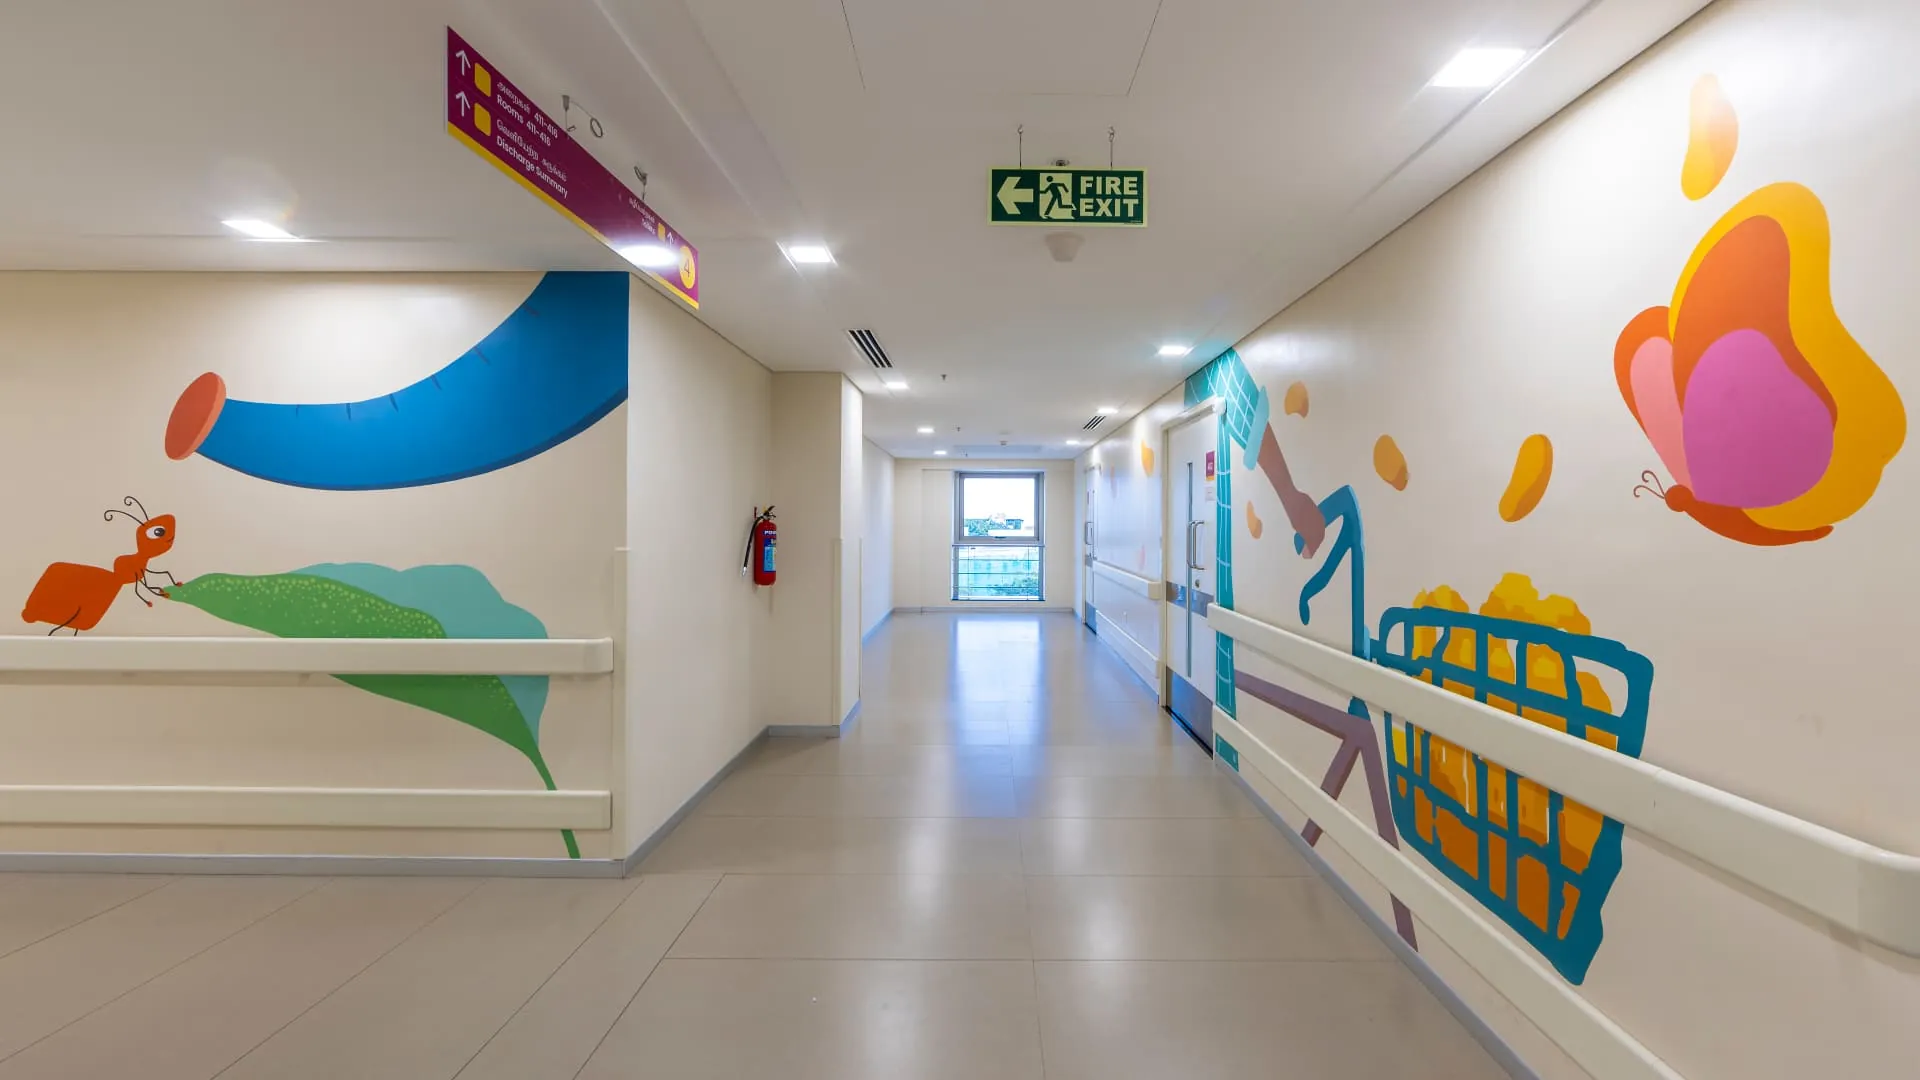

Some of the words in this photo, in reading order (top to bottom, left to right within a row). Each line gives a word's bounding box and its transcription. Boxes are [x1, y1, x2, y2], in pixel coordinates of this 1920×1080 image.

[497, 94, 524, 124] Rooms
[526, 120, 551, 147] 411-416
[534, 112, 558, 139] 411-416
[496, 135, 535, 172] Discharge
[535, 166, 568, 199] Summary
[1080, 176, 1138, 195] FIRE
[1080, 198, 1139, 217] EXIT
[684, 258, 691, 278] 4
